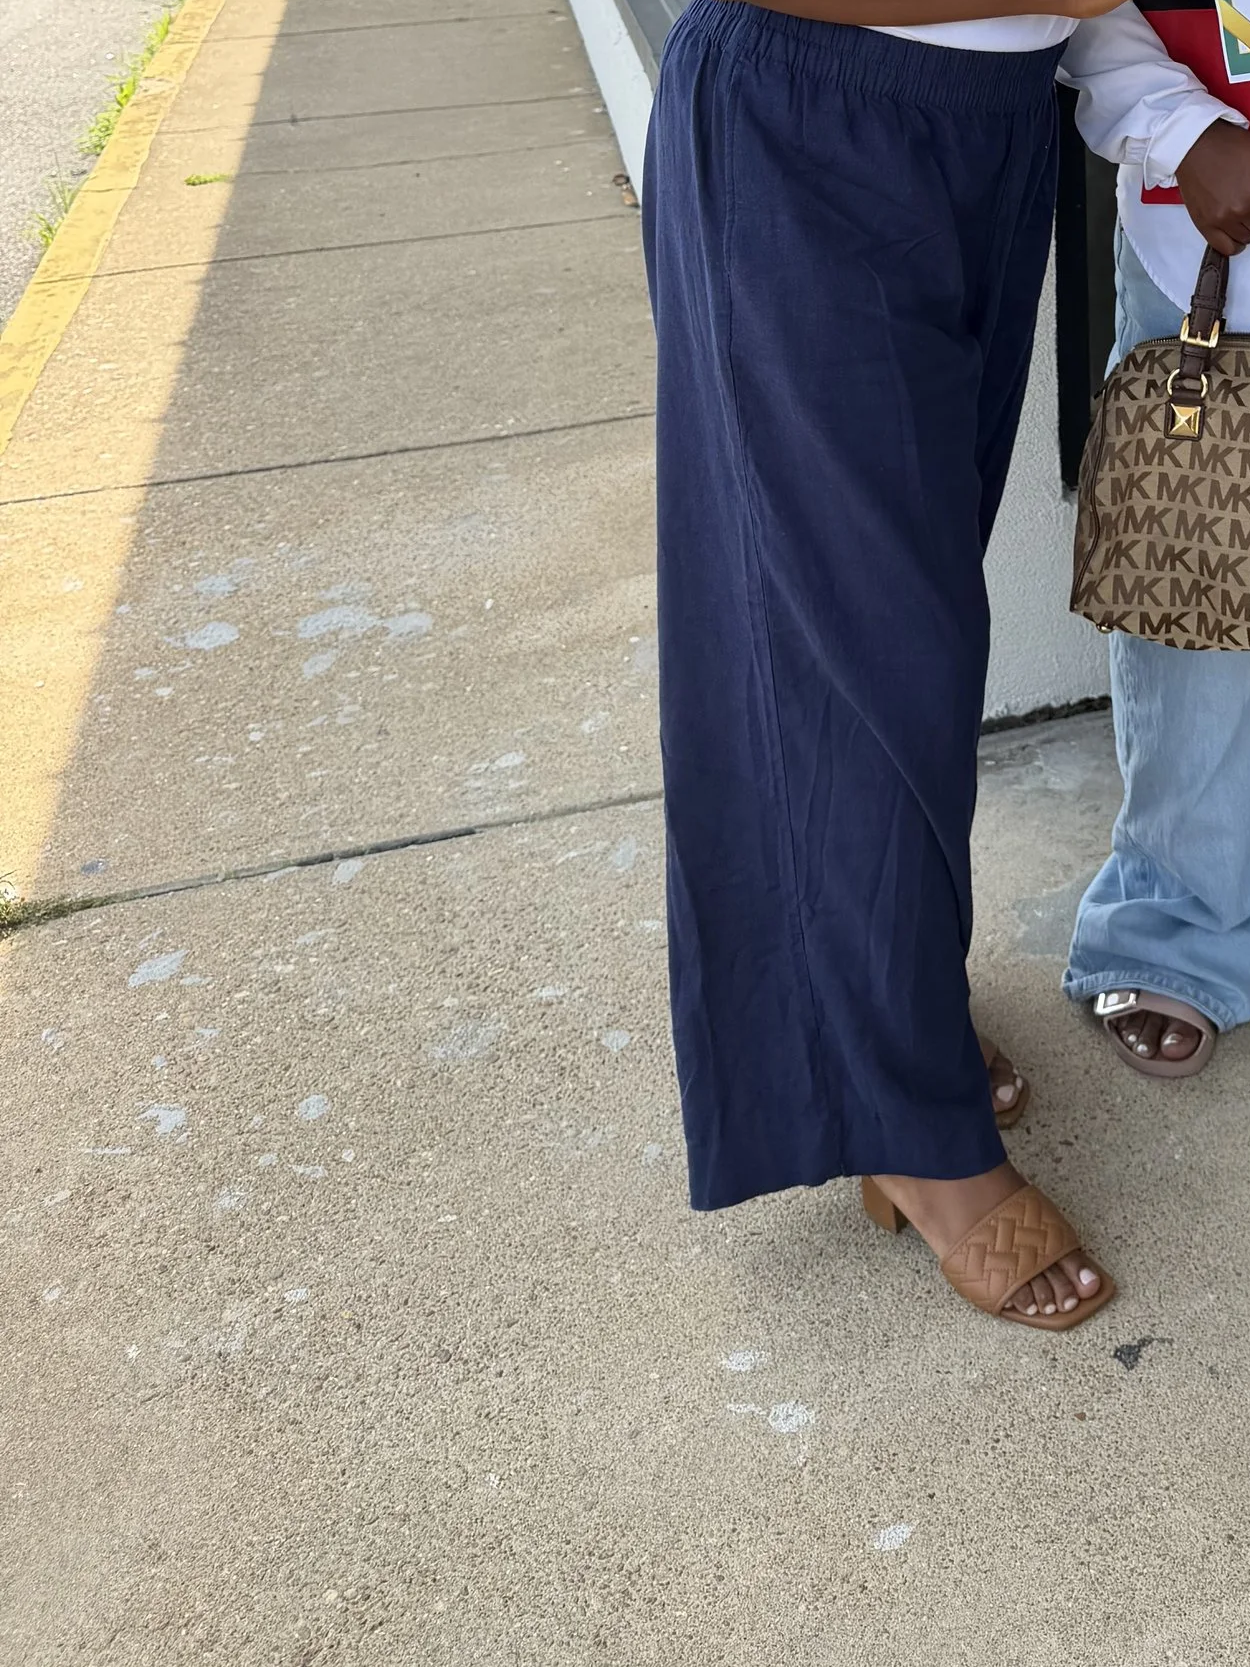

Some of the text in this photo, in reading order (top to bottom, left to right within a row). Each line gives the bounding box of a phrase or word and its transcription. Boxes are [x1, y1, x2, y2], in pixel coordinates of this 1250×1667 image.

[1123, 349, 1174, 374] MK
[1115, 404, 1163, 435] MK
[1134, 438, 1184, 468] MK
[1189, 441, 1236, 476] MK
[1110, 471, 1152, 506] MK
[1156, 472, 1206, 507] MK
[1123, 505, 1173, 537] MK
[1174, 510, 1225, 546] MK
[1145, 541, 1194, 573] MK
[1198, 550, 1249, 587] MK
[1112, 574, 1164, 607] MK
[1169, 577, 1216, 612] MK
[1139, 612, 1191, 635] MK
[1196, 611, 1243, 647] MK
